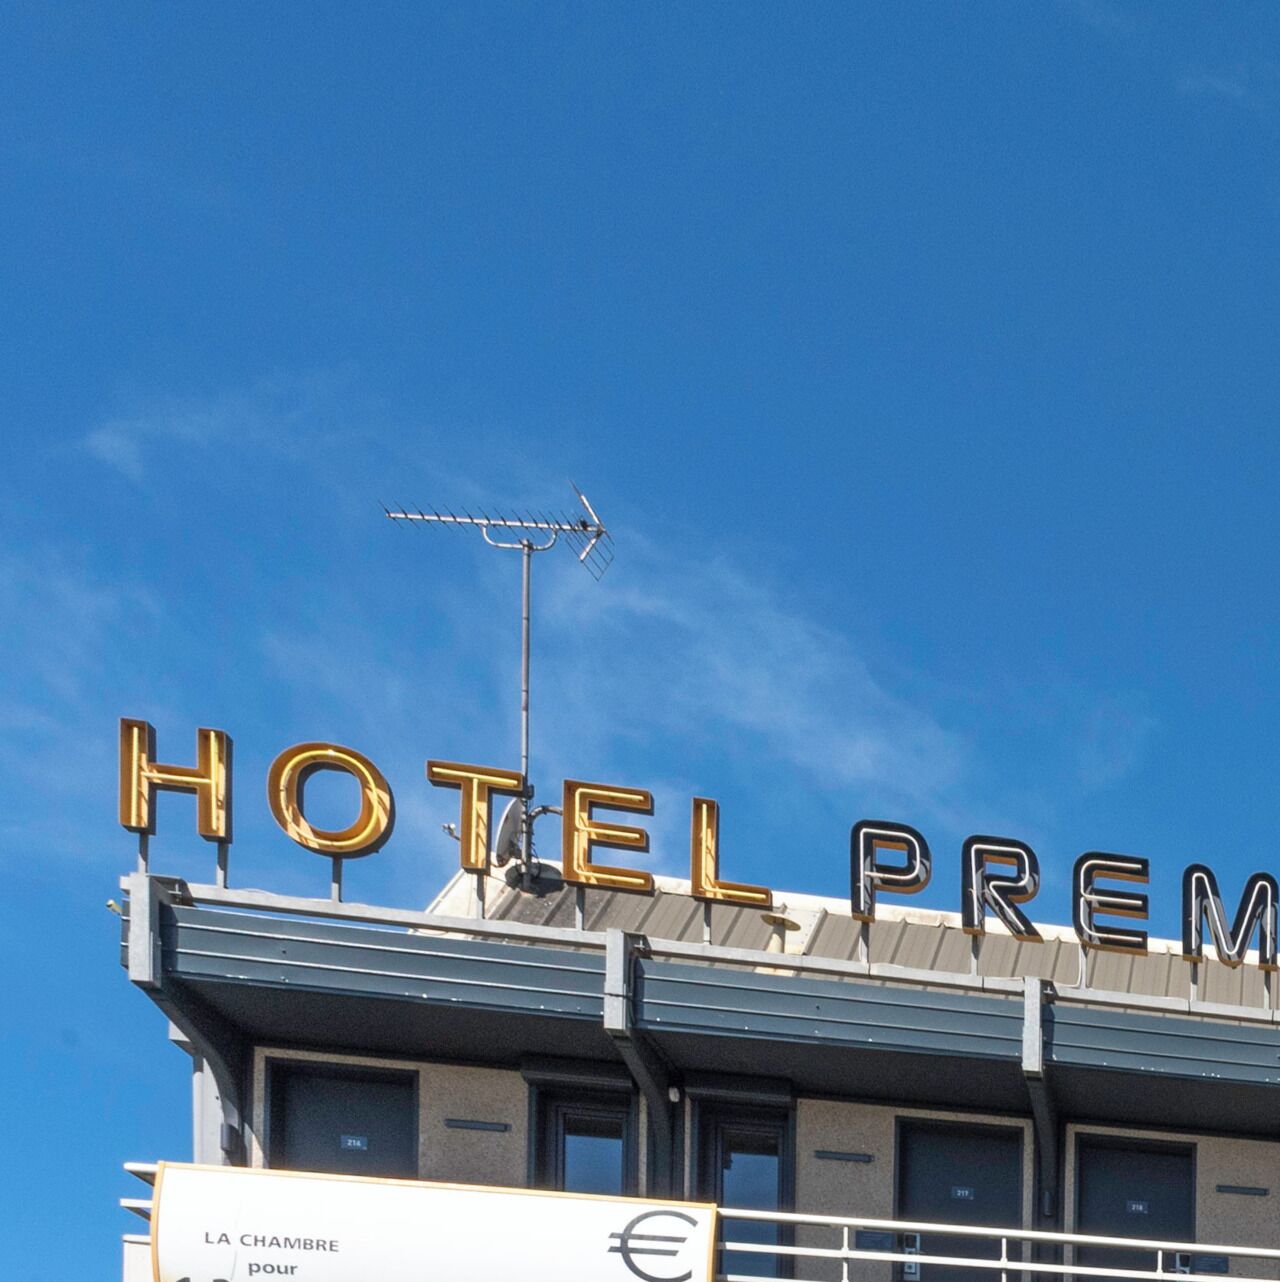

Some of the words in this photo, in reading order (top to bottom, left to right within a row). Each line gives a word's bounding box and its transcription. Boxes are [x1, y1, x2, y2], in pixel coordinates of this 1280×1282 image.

[119, 717, 772, 906] HOTEL
[204, 1231, 231, 1245] LA
[239, 1233, 339, 1252] CHAMBRE
[247, 1261, 299, 1276] pour
